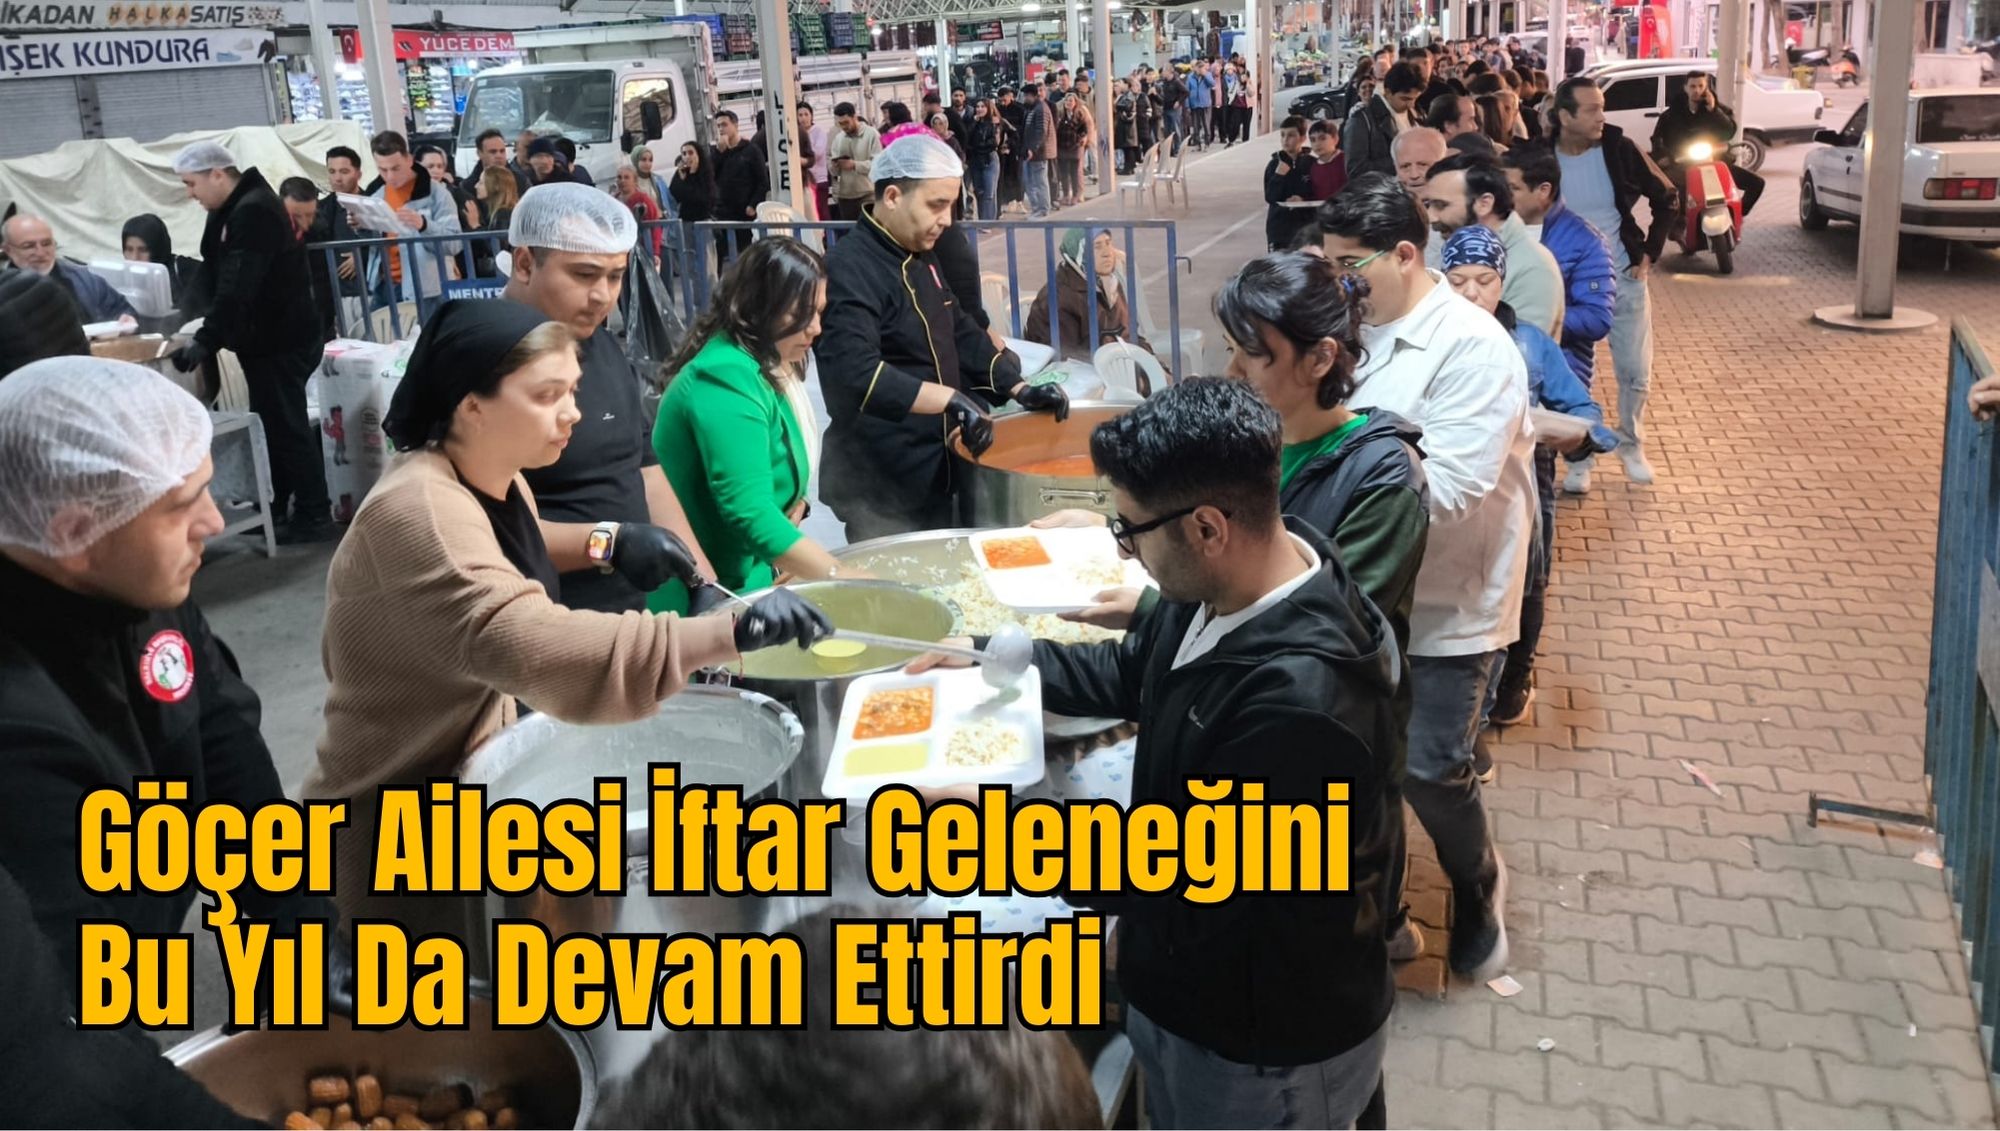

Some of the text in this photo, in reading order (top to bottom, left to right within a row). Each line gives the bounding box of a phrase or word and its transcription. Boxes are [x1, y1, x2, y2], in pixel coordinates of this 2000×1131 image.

[108, 6, 187, 21] HALKA
[420, 33, 514, 51] YÜCE DEM
[72, 38, 210, 67] KUNDURA
